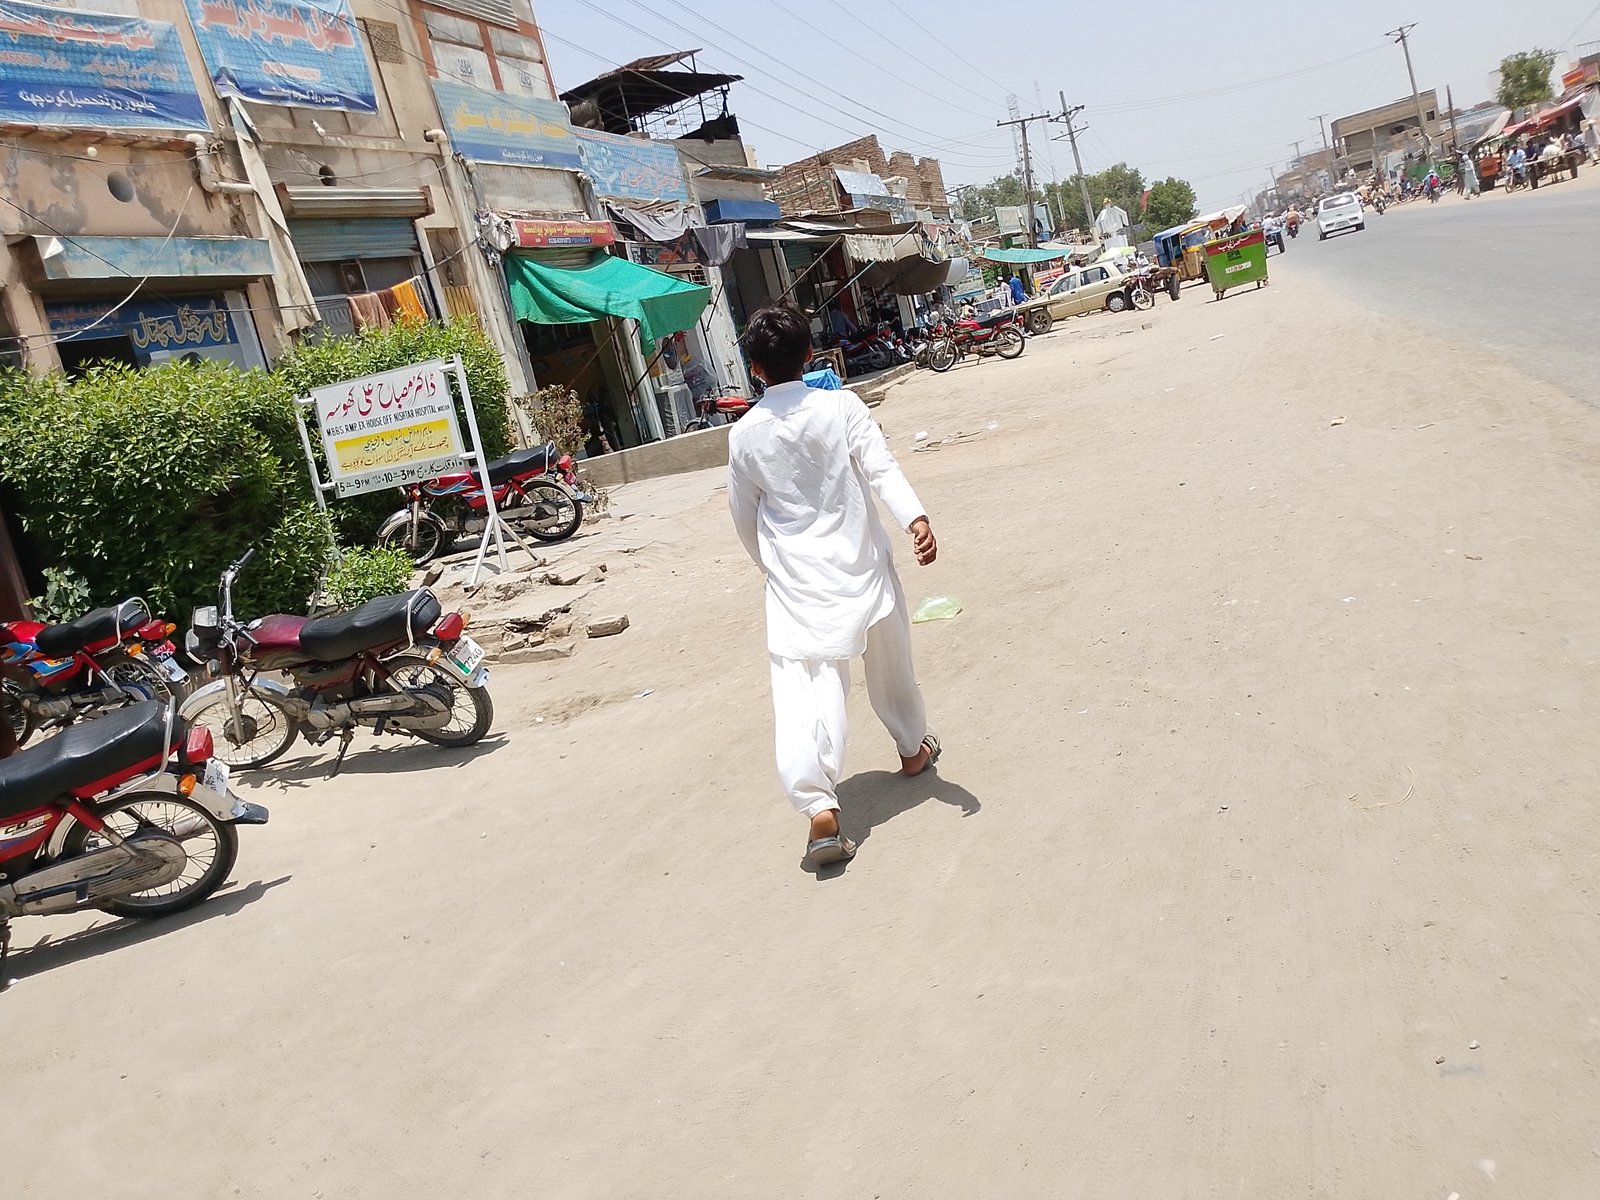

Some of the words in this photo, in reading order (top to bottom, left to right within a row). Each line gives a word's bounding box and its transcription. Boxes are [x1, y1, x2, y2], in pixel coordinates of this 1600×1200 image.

[357, 383, 373, 416] علی
[378, 380, 413, 409] مصباح
[410, 370, 436, 406] ڈاکٹر
[393, 408, 415, 422] NISHTAR
[414, 404, 437, 417] HOSPITAL
